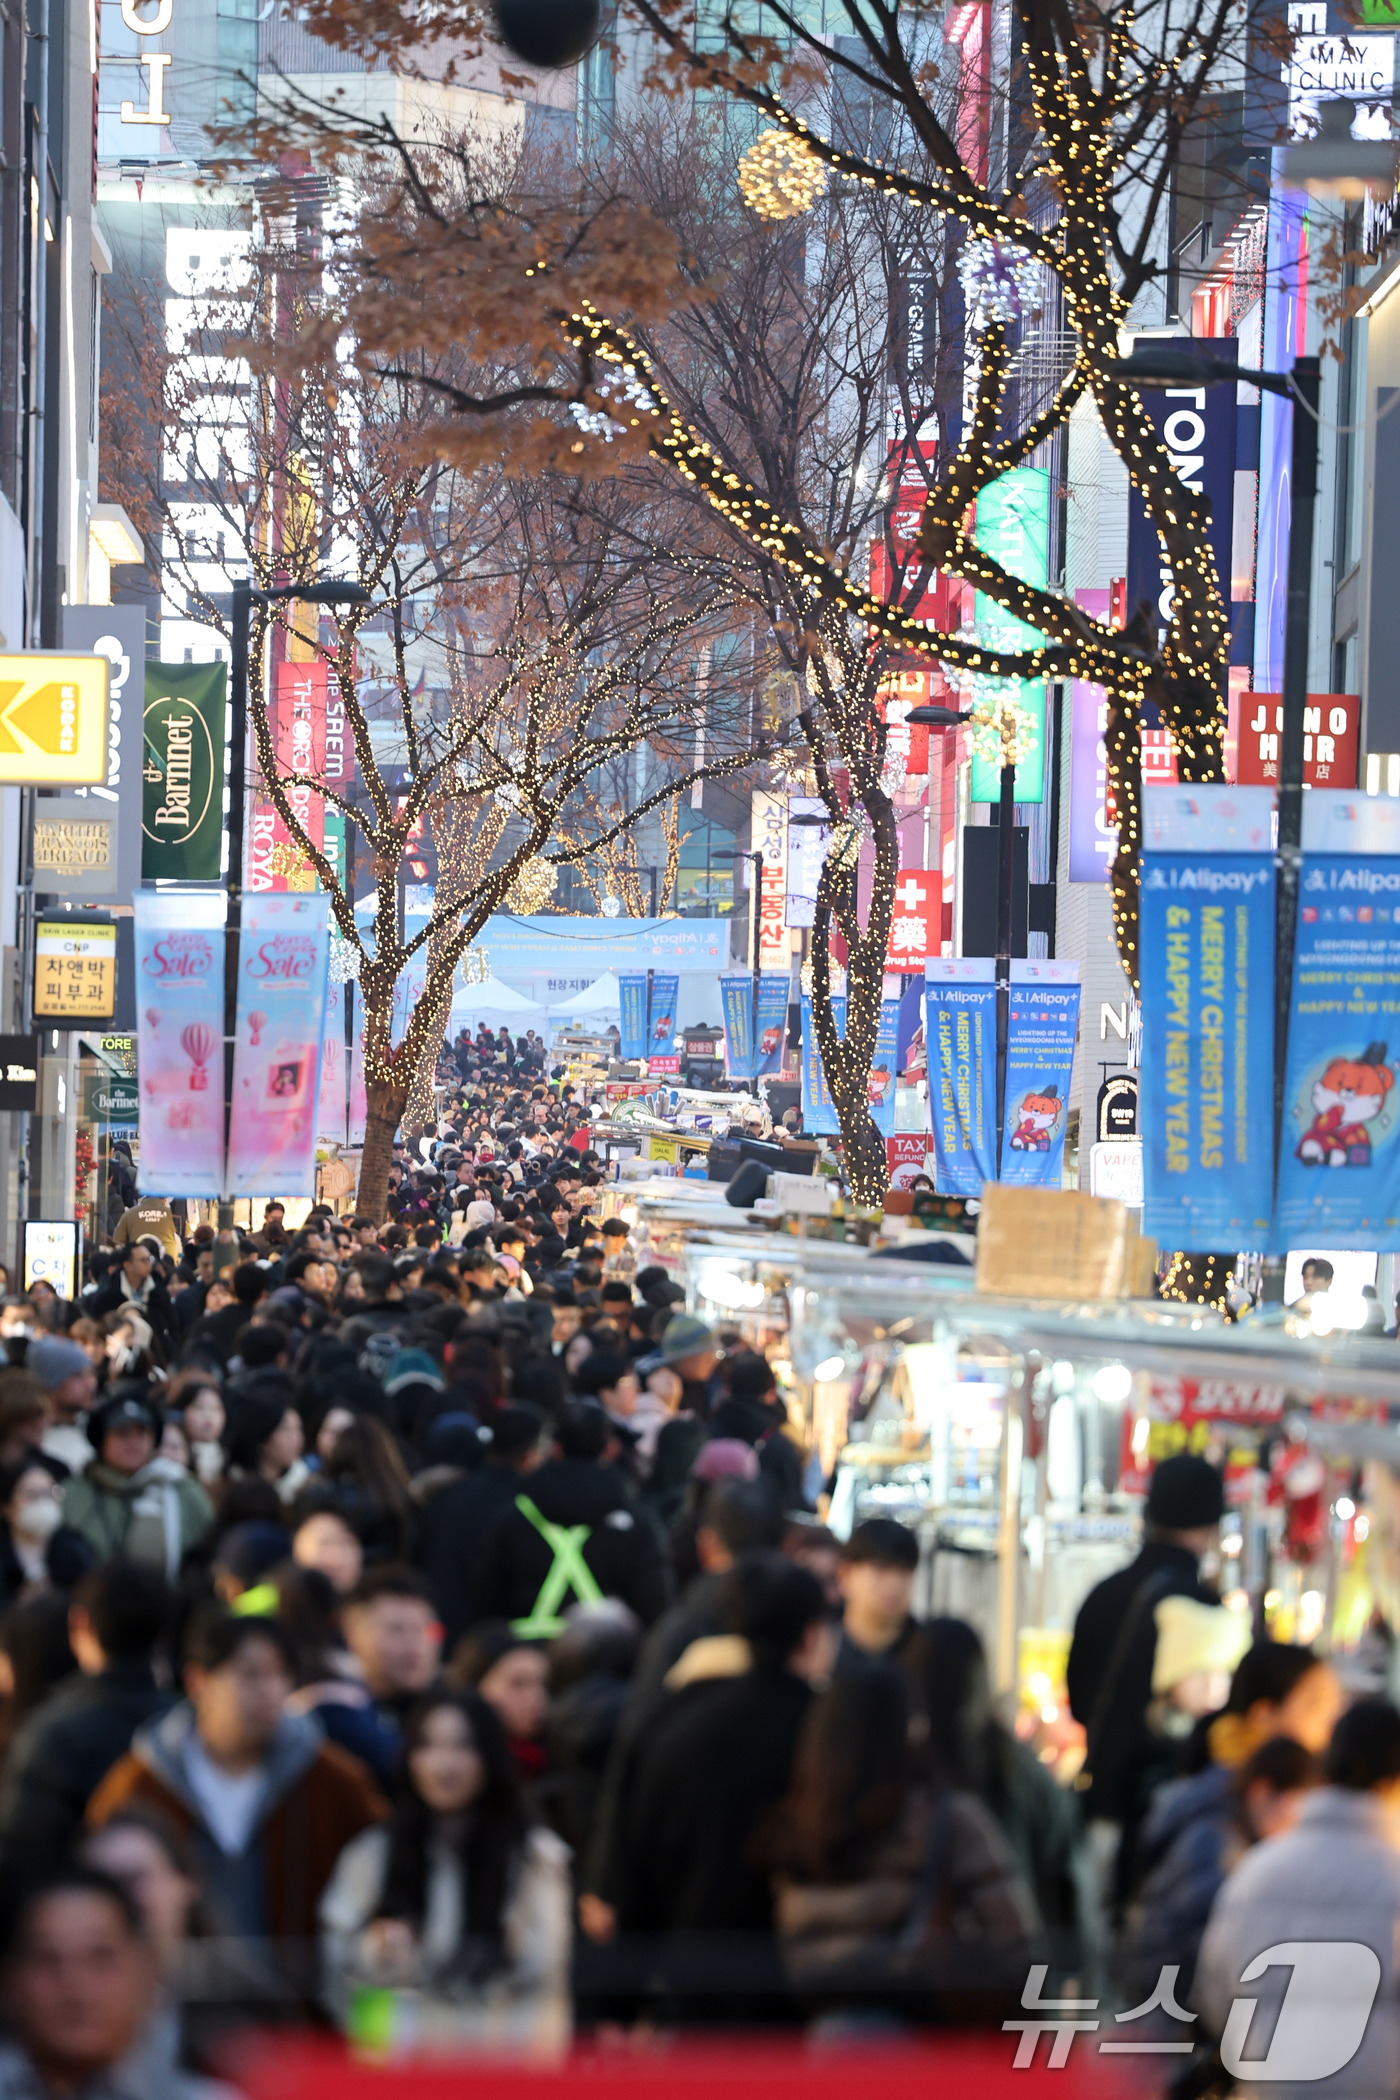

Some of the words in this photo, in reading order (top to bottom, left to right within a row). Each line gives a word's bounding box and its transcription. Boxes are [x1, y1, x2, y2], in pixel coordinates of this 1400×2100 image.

[1319, 46, 1368, 65] MAY
[1300, 71, 1384, 91] CLINIC
[60, 685, 76, 752] KODAK
[325, 700, 345, 778] SAEM
[1259, 733, 1335, 763] HIR
[155, 713, 194, 828] Barnnet
[760, 866, 785, 949] 부동산
[1166, 905, 1191, 929] &
[64, 942, 89, 952] CNP
[1200, 906, 1225, 1000] MERRY
[46, 958, 106, 981] 차앤박
[1166, 932, 1191, 1027] HAPPY
[46, 983, 104, 1001] 피부과
[938, 1010, 951, 1022] &
[939, 1024, 952, 1075] HAPPY
[957, 1011, 970, 1062] MERRY
[975, 1046, 982, 1056] UP
[7, 1064, 36, 1081] Kim
[1165, 1030, 1191, 1096] NEW
[114, 1089, 126, 1097] the
[810, 1080, 818, 1107] YEAR
[941, 1078, 955, 1112] NEW
[1200, 1004, 1225, 1169] CHRISTMAS
[957, 1064, 972, 1151] CHRISTMAS
[895, 1139, 925, 1152] TAX
[943, 1114, 956, 1153] YEAR
[1165, 1100, 1190, 1174] YEAR
[1103, 1155, 1140, 1165] VAPE
[37, 1233, 64, 1243] CNP
